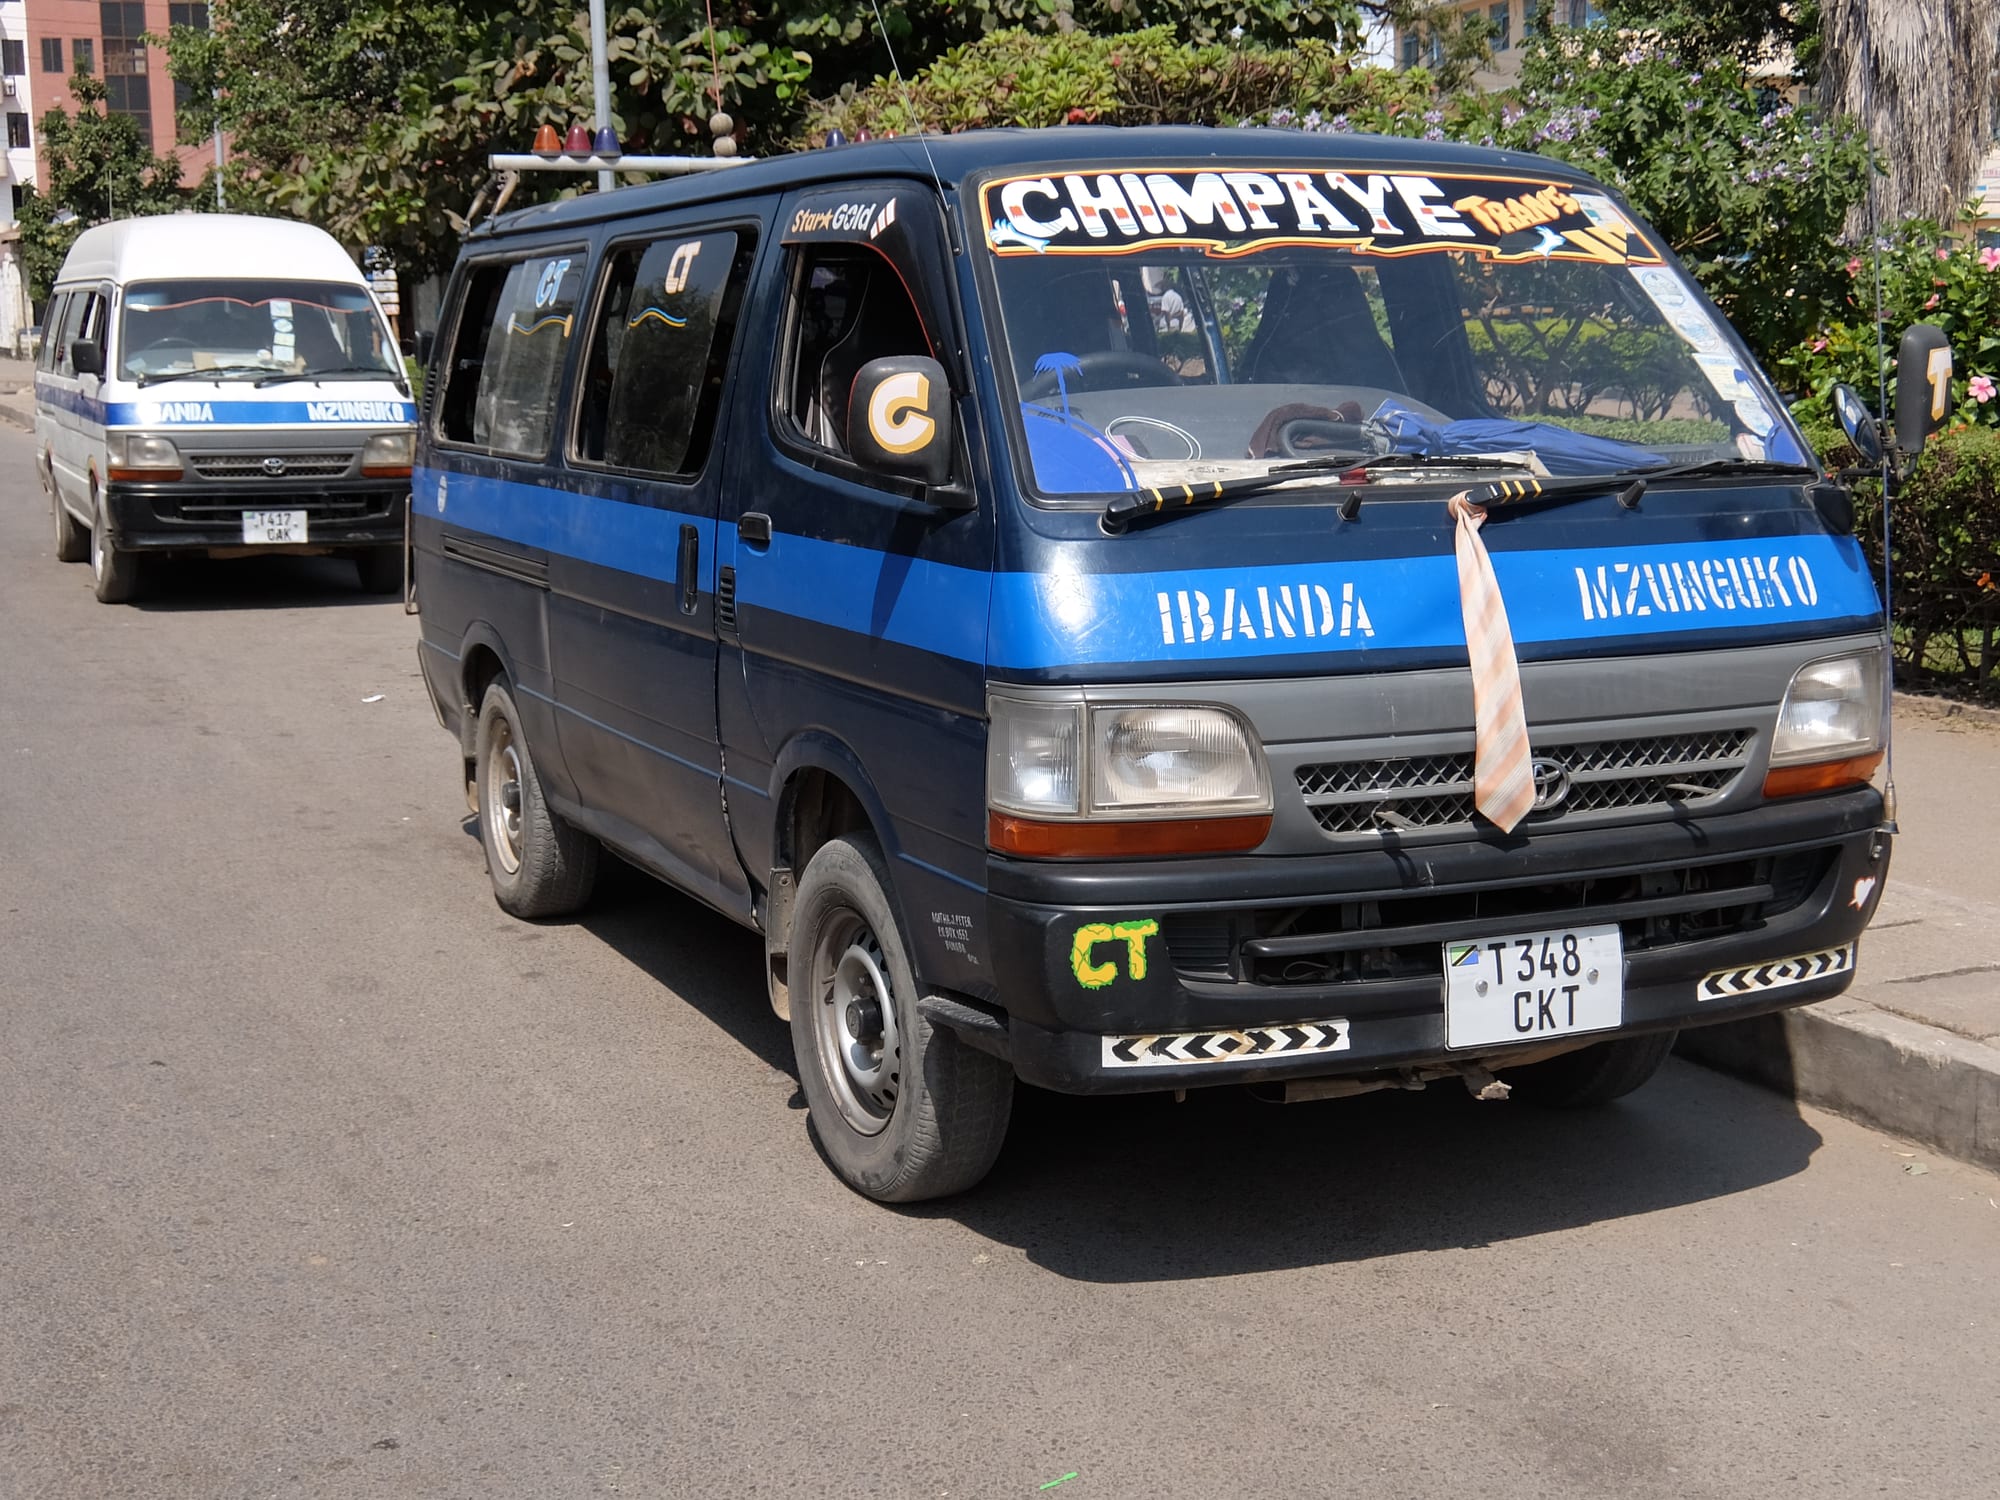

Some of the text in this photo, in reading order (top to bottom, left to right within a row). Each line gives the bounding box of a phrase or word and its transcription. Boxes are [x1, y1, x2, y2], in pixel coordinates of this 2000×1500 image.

[791, 208, 823, 233] Star
[1000, 172, 1580, 238] CHIMPAYE TRANS
[535, 259, 571, 308] CT
[665, 240, 701, 294] CT
[306, 402, 405, 422] MZUNGUKO
[868, 372, 935, 454] C
[1156, 555, 1818, 644] IBANDA MZUNGUKO
[1069, 919, 1159, 991] CT
[1513, 984, 1580, 1033] CKT
